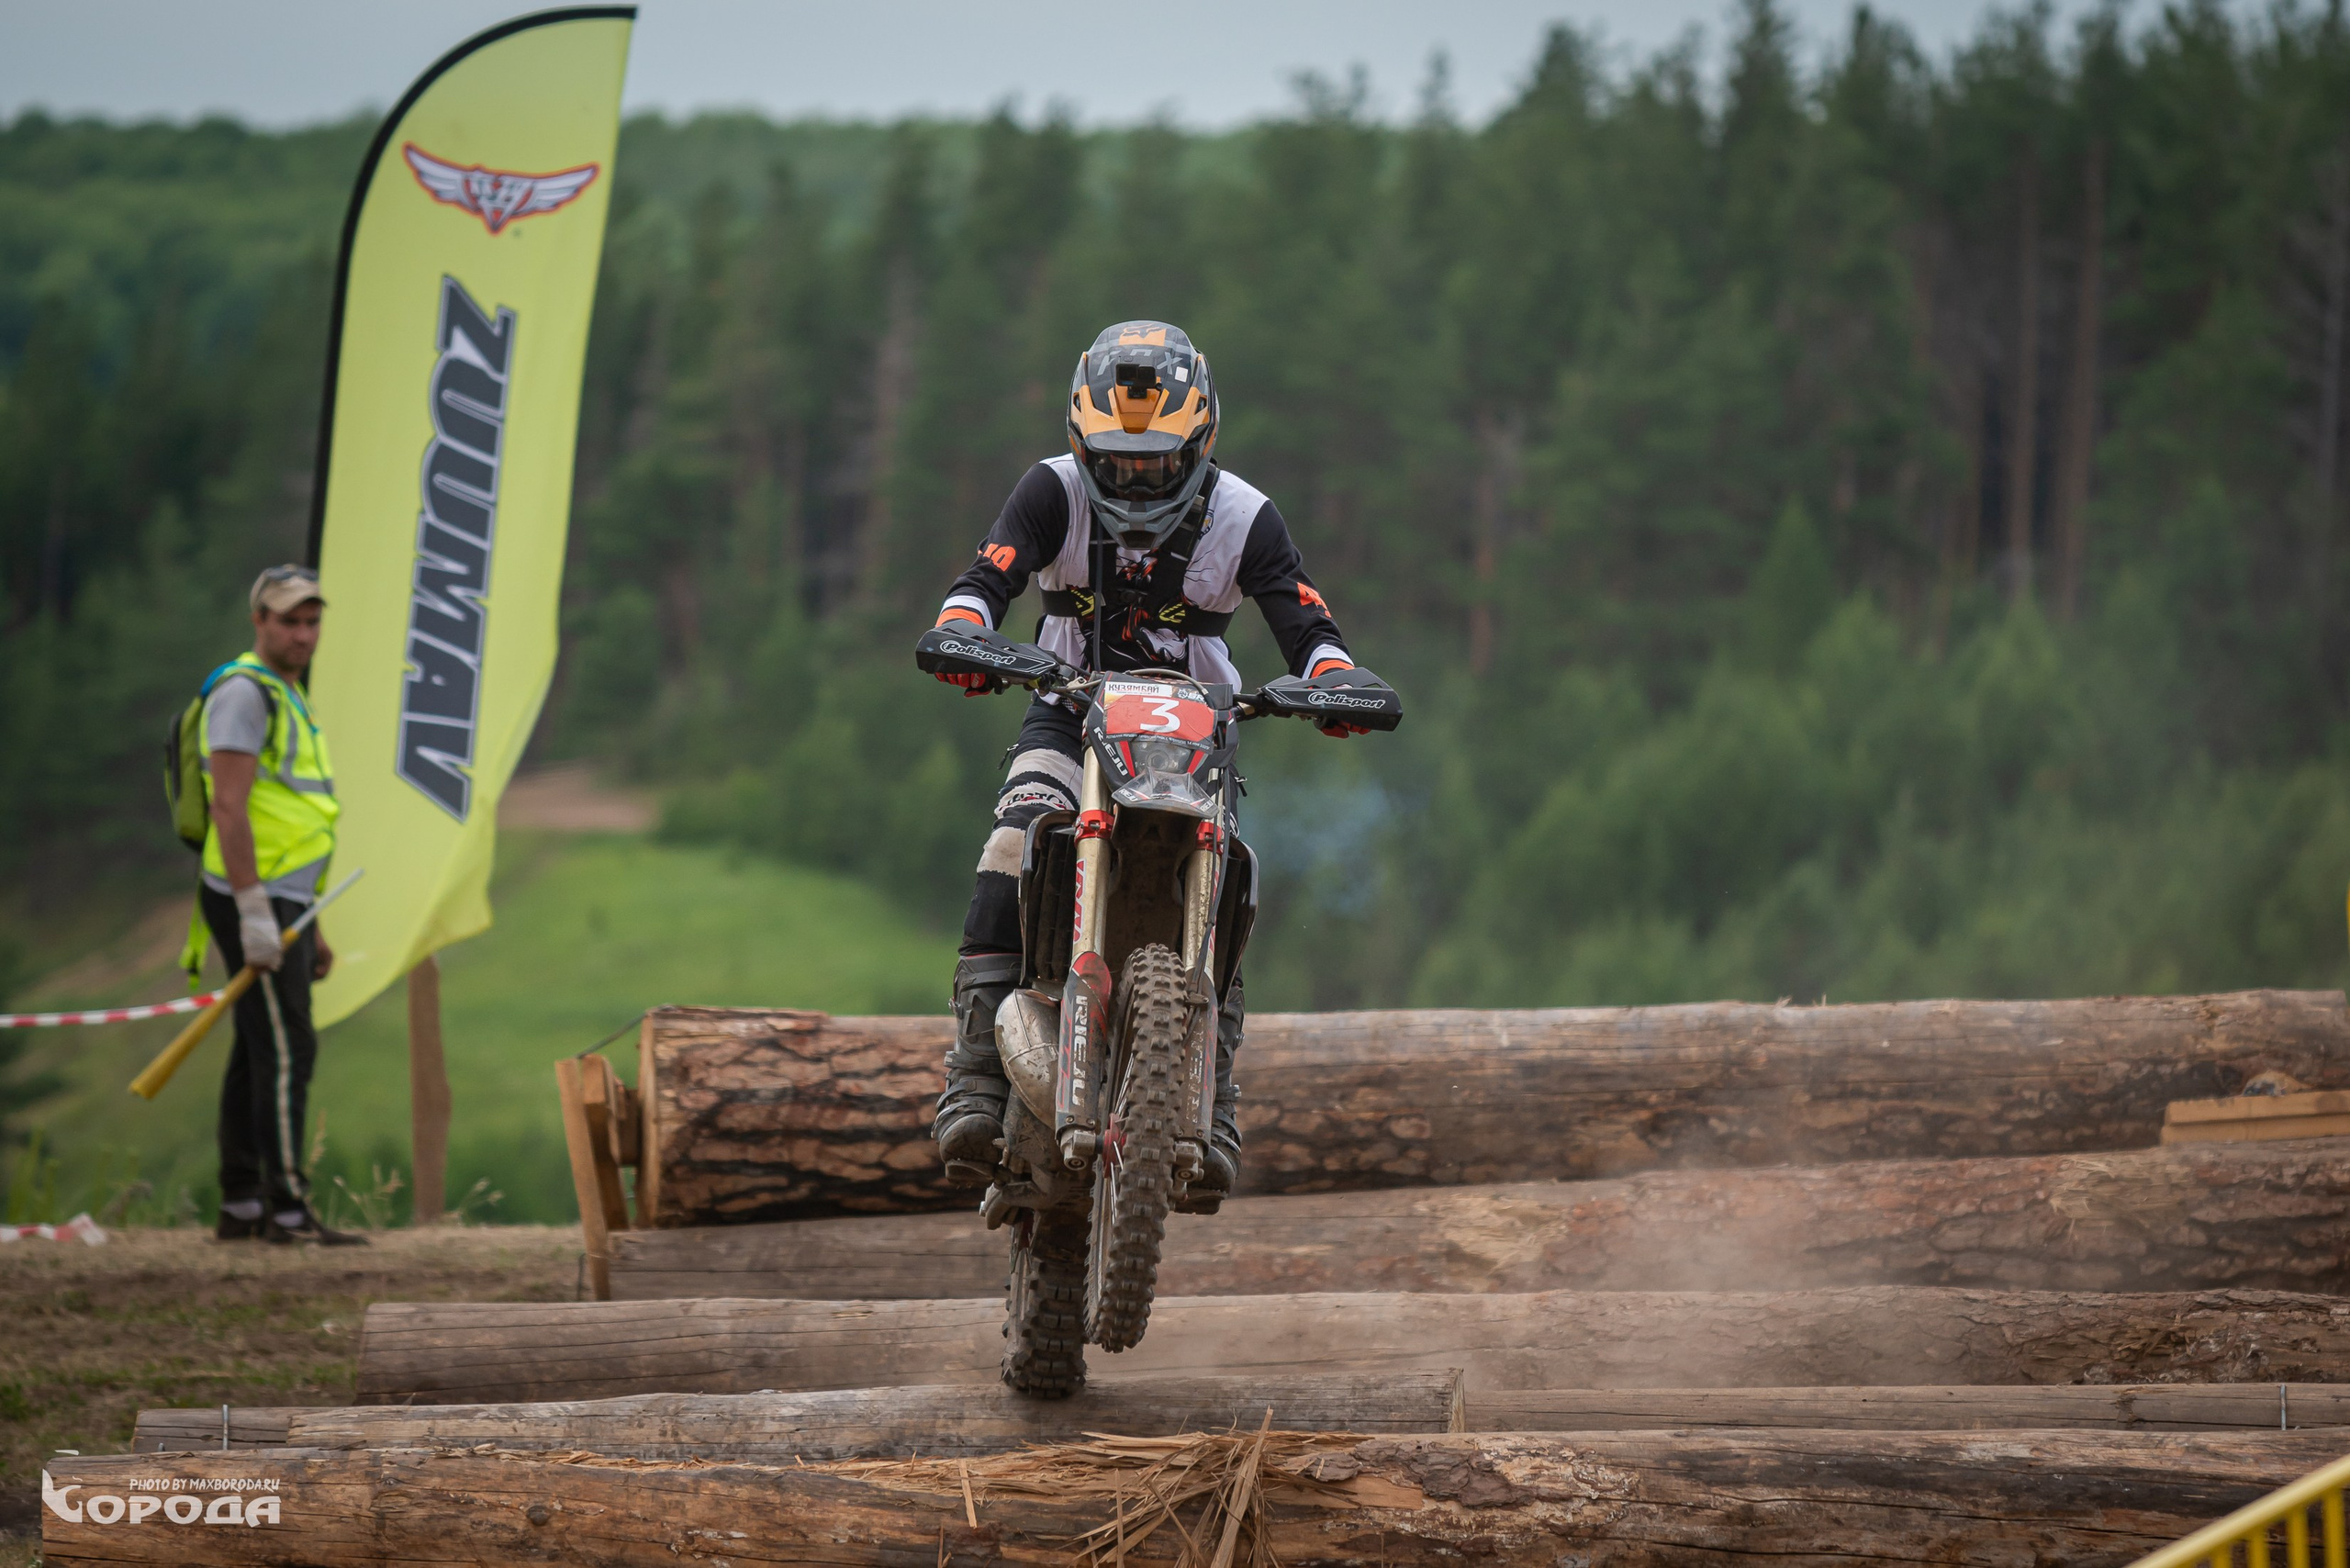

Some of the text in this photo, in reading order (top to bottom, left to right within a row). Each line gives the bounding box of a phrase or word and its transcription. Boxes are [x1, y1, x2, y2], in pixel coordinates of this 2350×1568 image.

[396, 274, 518, 823] ZUUMAV
[939, 640, 1017, 665] Polisport
[1108, 683, 1159, 694] КУЗЯМБАЙ
[1307, 691, 1386, 710] Polisport
[1139, 697, 1181, 734] 3
